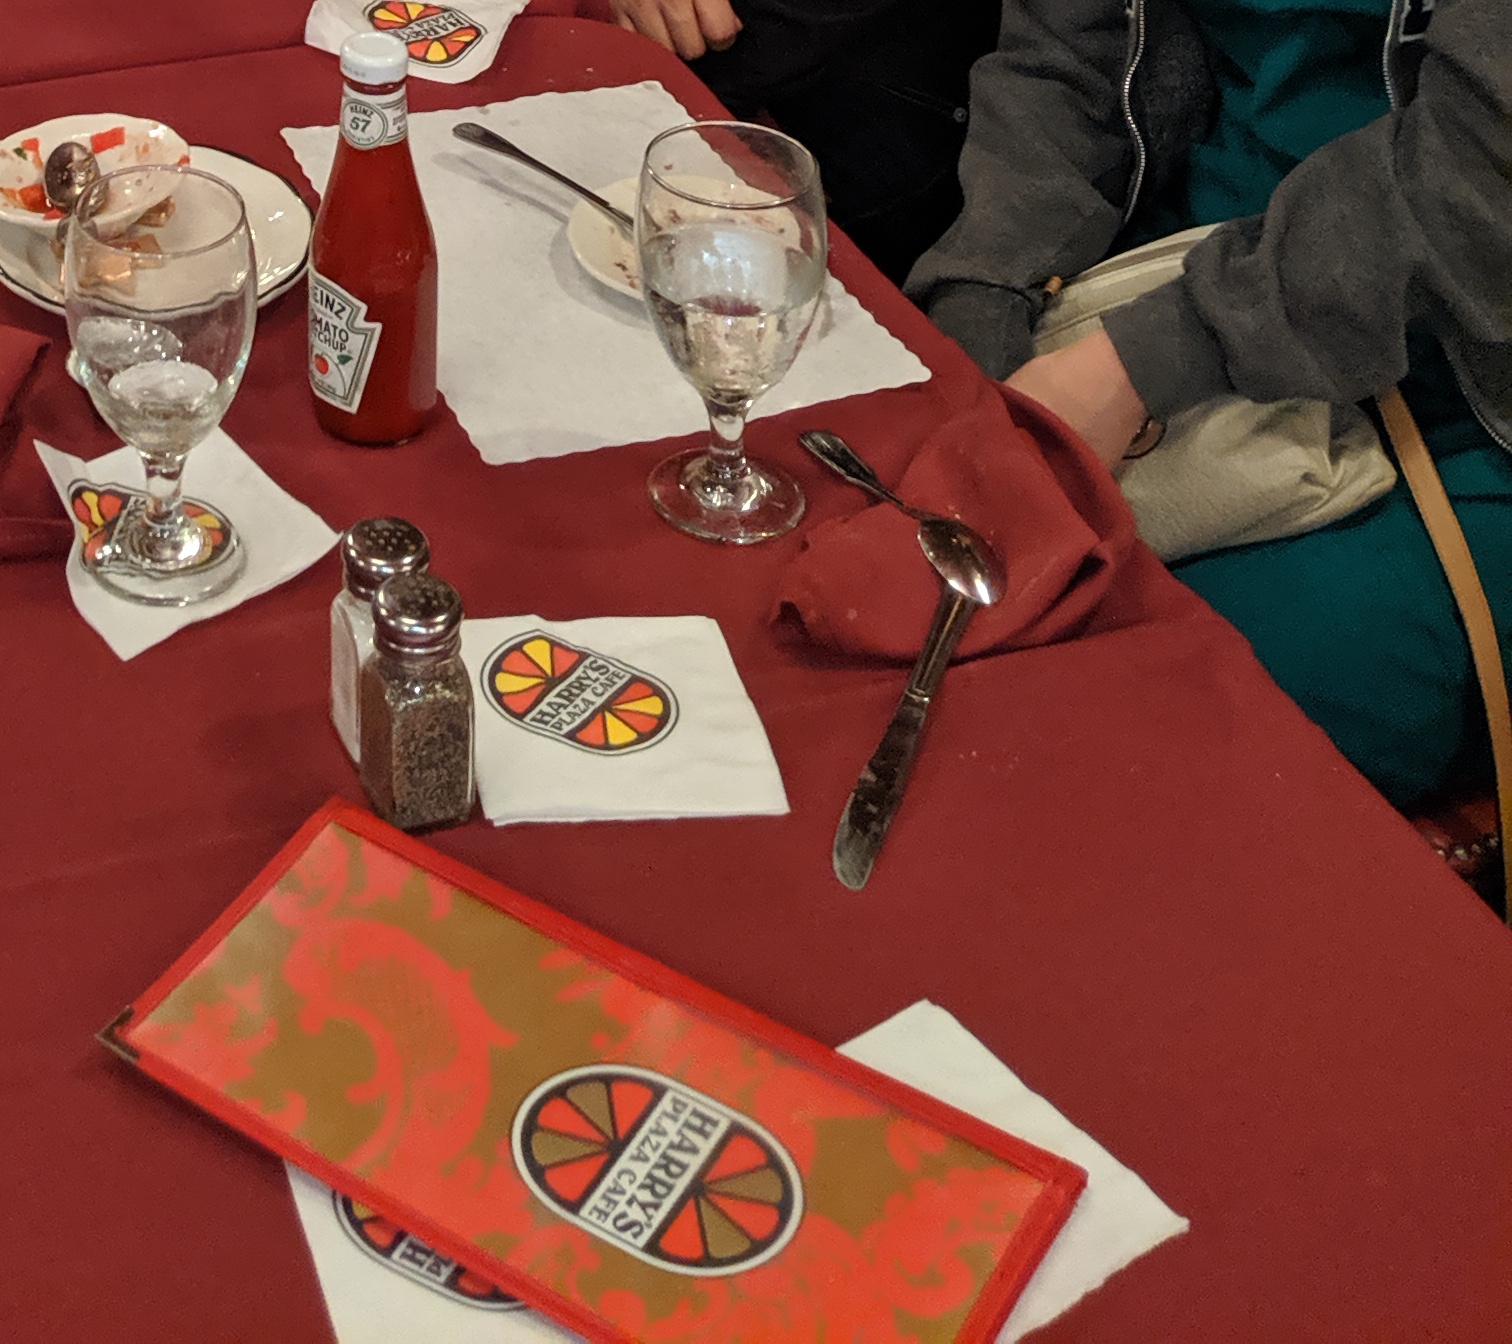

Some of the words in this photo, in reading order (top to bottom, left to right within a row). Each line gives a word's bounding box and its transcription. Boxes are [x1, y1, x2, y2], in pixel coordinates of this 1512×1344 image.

[349, 104, 375, 120] HEINZ
[349, 116, 371, 133] 57
[312, 284, 347, 321] EINZ
[311, 314, 349, 343] MATO
[313, 328, 347, 353] CHUP
[529, 658, 610, 726] HARRY'S
[549, 697, 597, 731] PLAZA
[591, 670, 626, 697] CAFE
[629, 1096, 689, 1164] PLAZA
[589, 1167, 637, 1224] CAFE
[612, 1107, 720, 1240] HARRY'S
